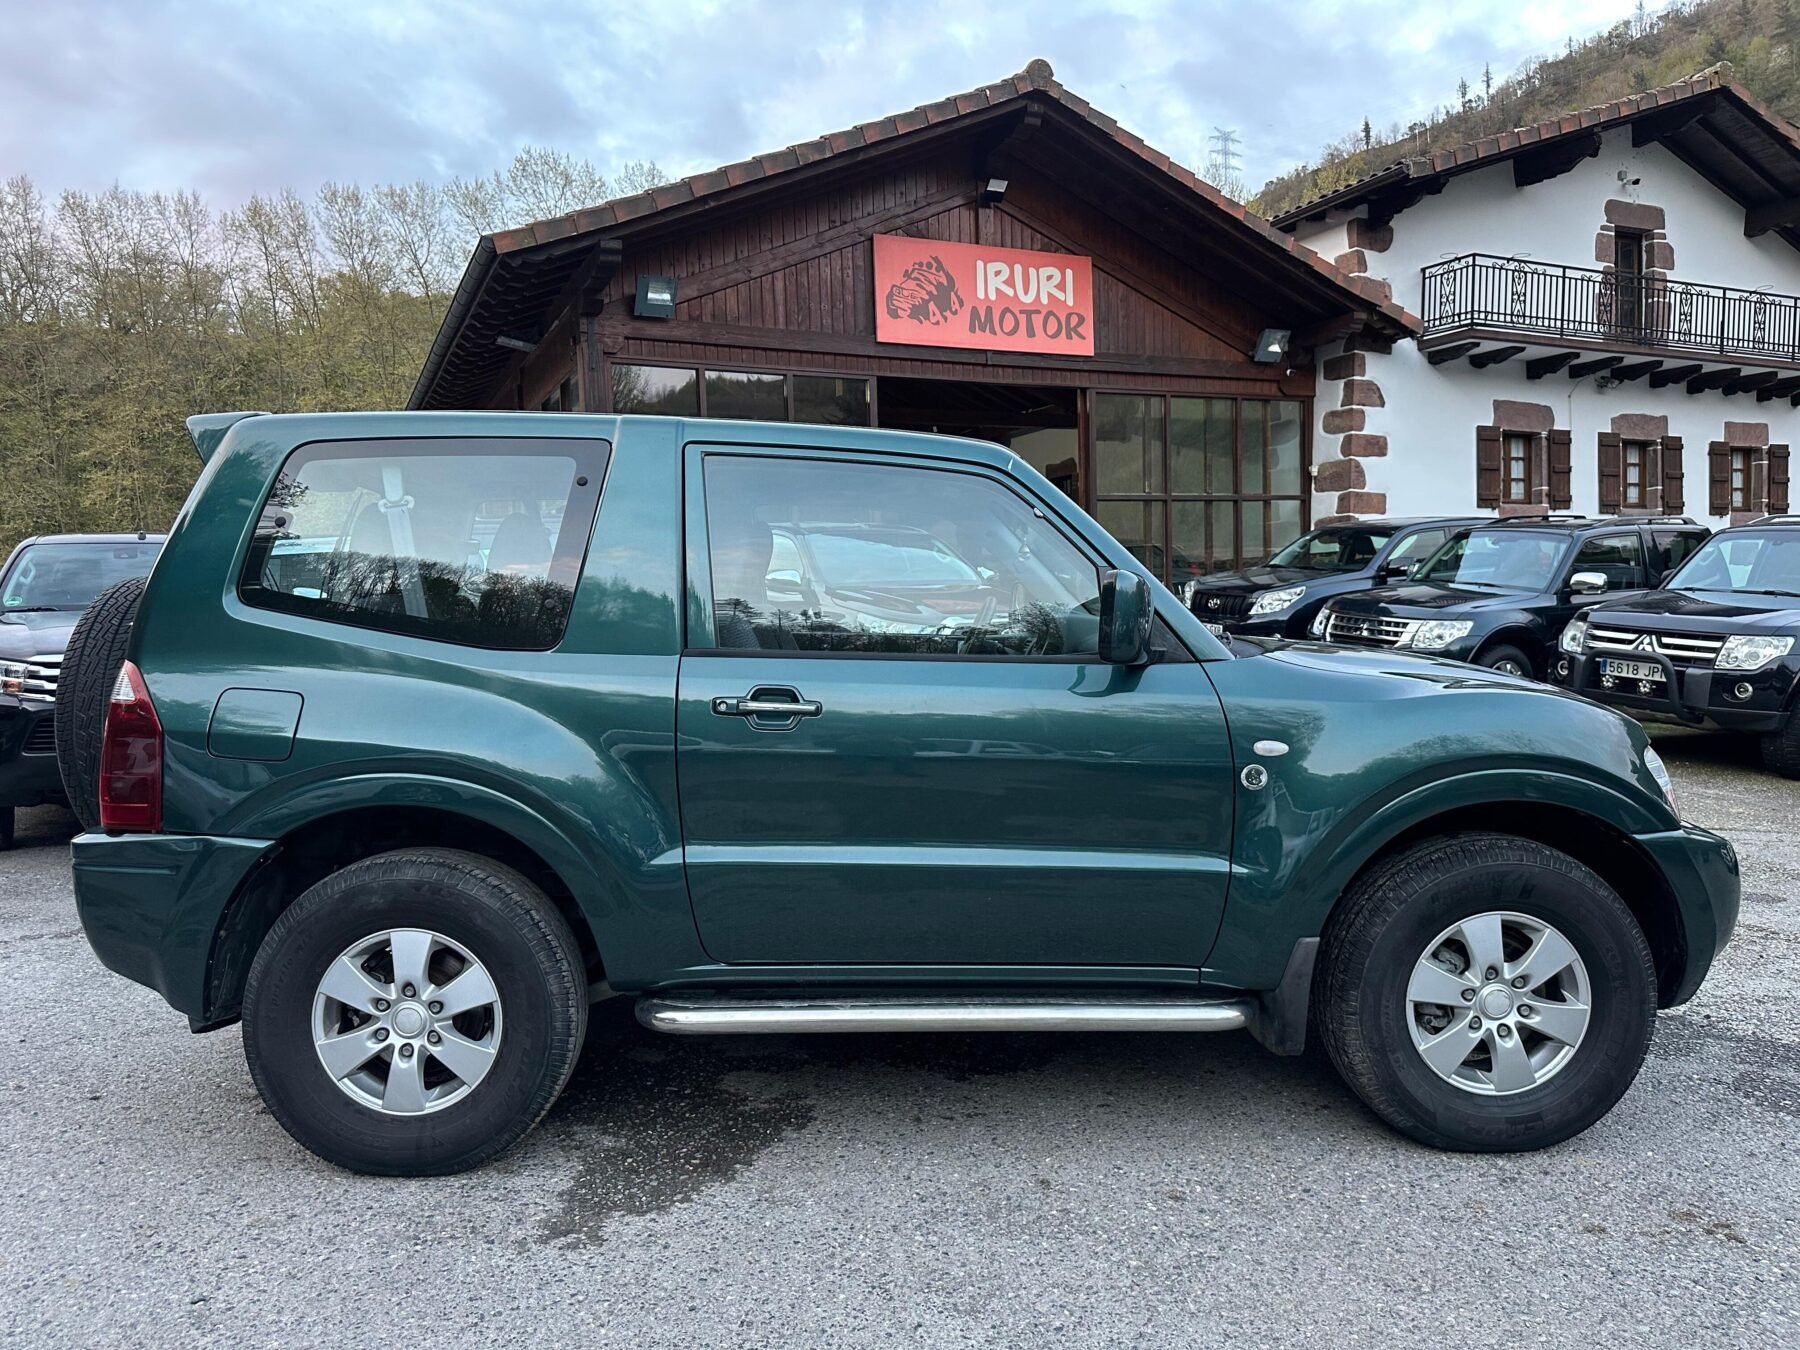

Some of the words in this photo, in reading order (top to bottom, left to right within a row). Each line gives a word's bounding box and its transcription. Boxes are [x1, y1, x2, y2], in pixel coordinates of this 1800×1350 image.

[976, 260, 1073, 306] IRURI
[968, 305, 1086, 340] MOTOR
[1608, 661, 1639, 676] 5618
